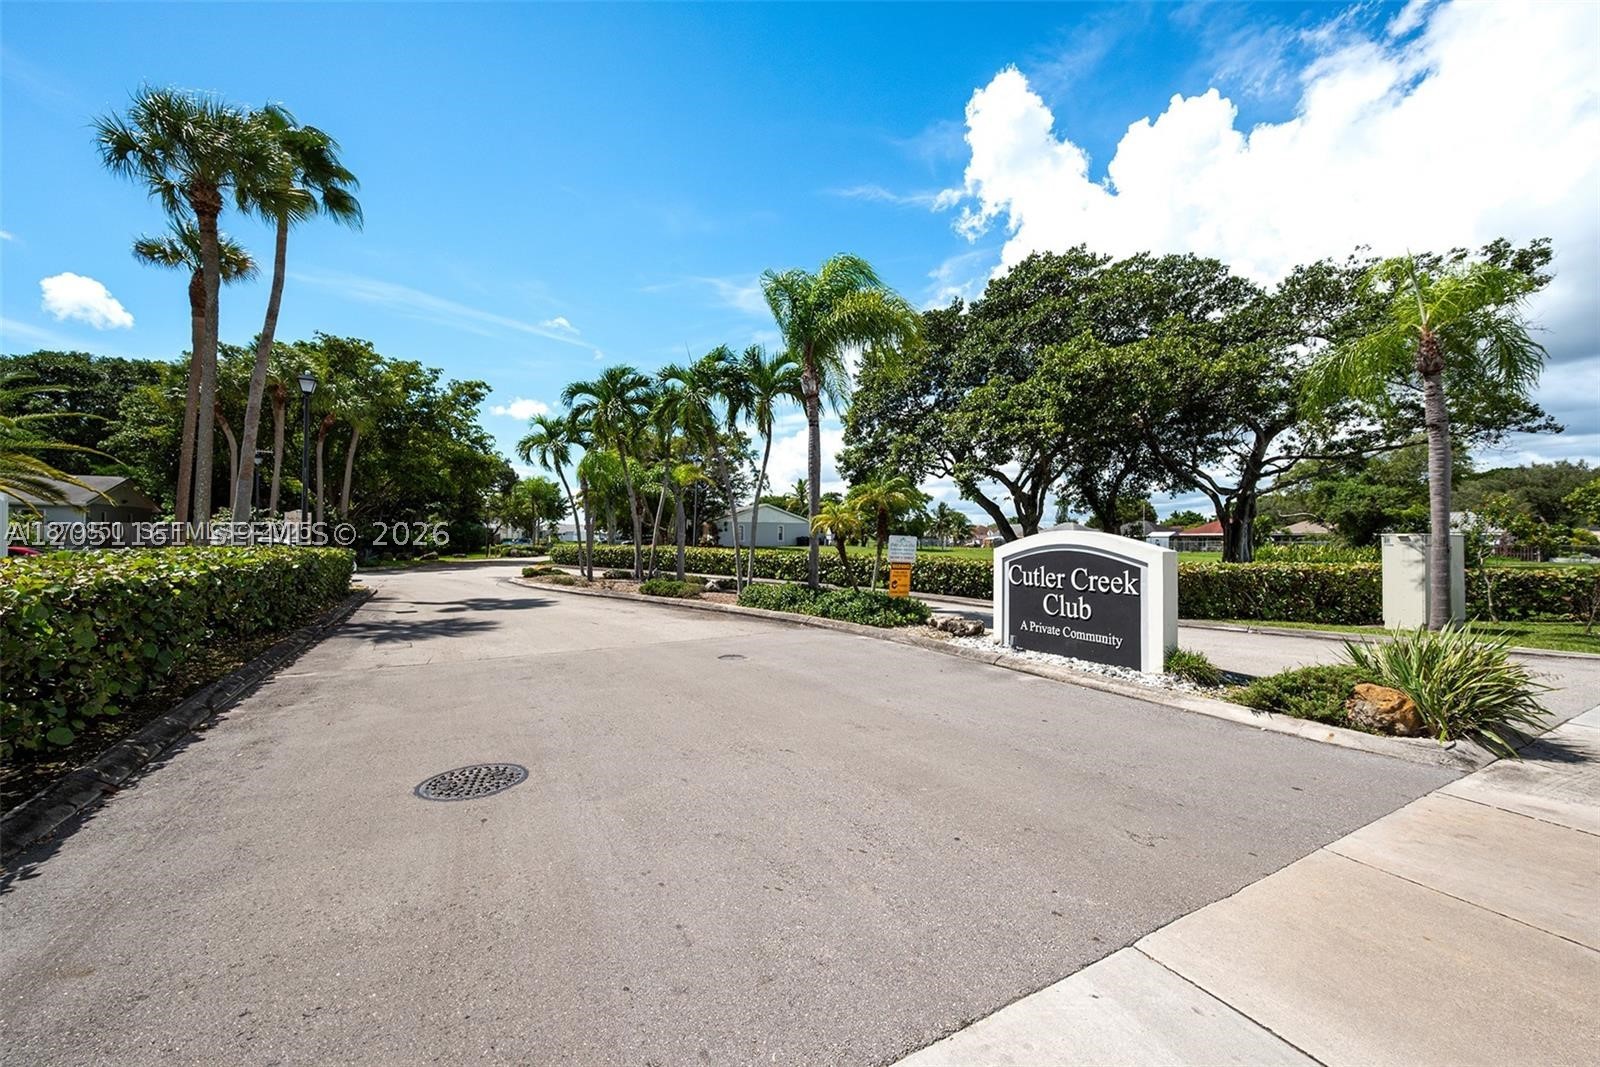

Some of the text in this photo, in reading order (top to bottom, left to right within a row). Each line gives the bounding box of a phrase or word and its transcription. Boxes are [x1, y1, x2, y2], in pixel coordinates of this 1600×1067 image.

[1008, 564, 1139, 596] Cutler Creek
[1042, 593, 1092, 620] Club
[1020, 620, 1123, 649] A Private Community
